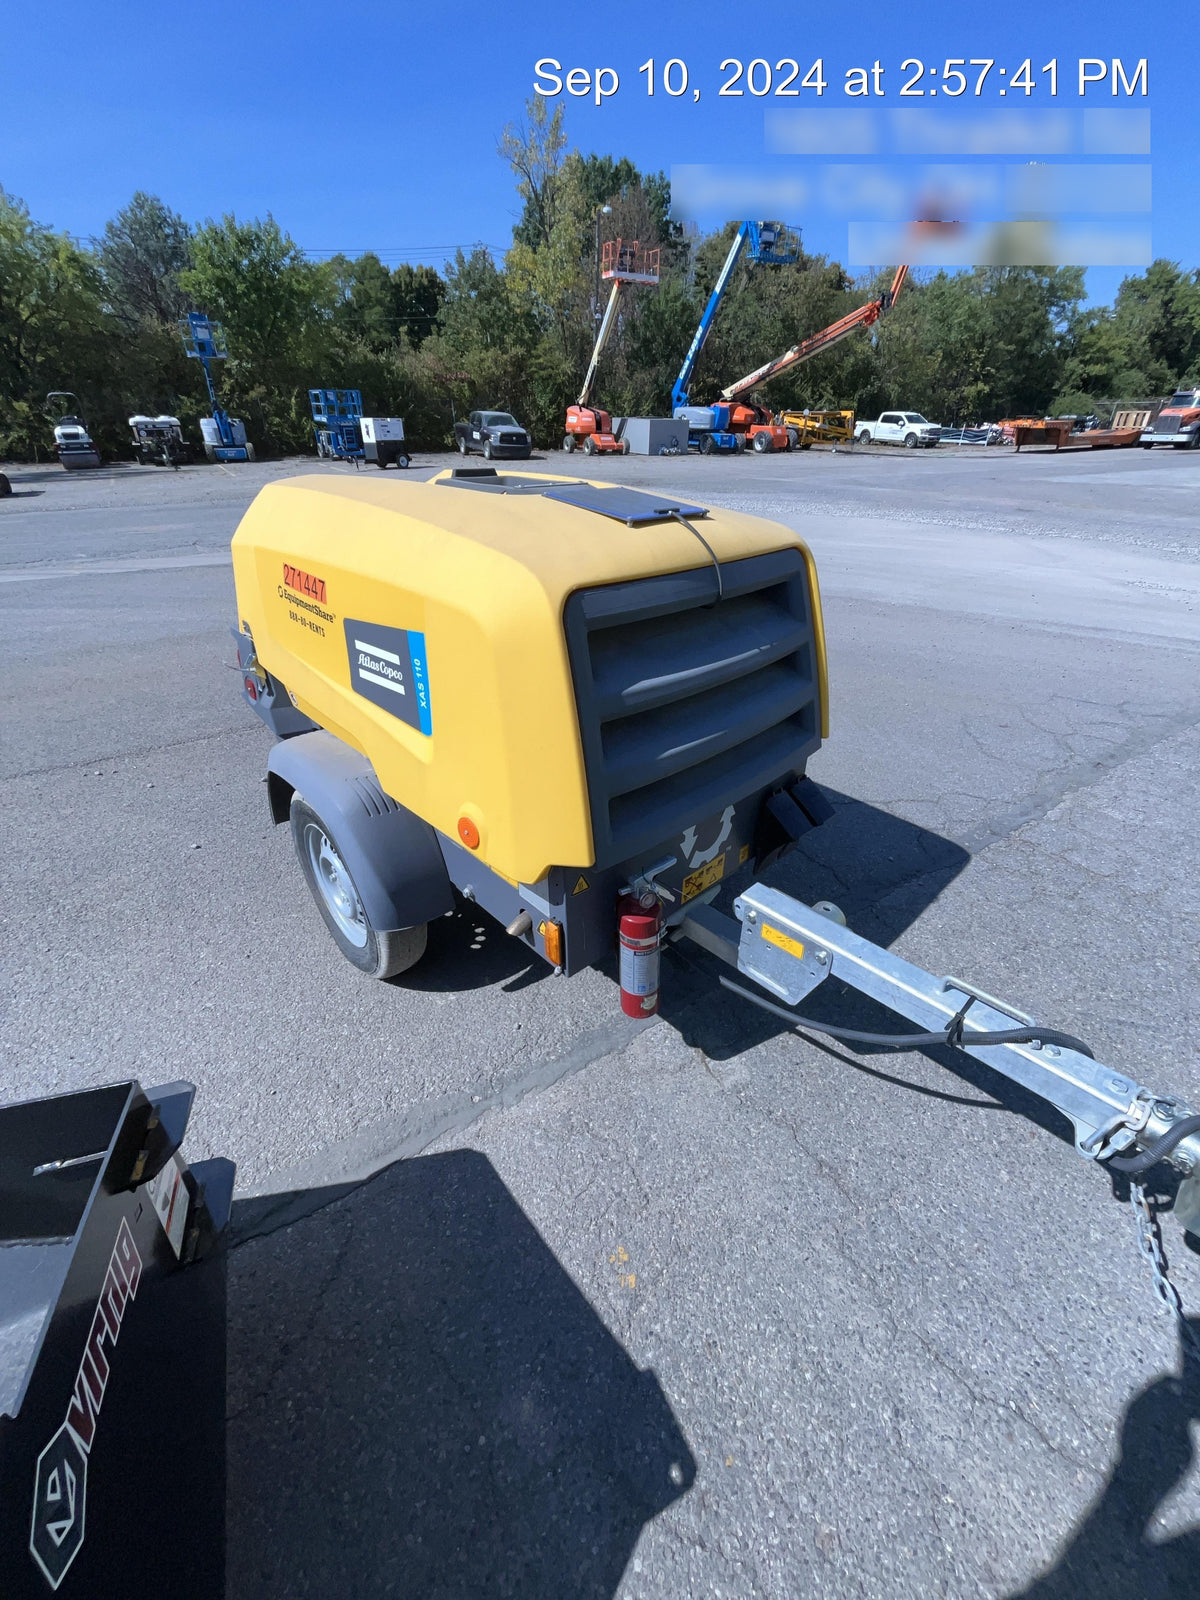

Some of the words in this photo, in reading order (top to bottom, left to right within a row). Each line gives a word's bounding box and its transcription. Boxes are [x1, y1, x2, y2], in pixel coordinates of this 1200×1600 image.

[283, 563, 326, 602] 271447
[283, 588, 334, 623] EquipmentShare
[358, 653, 380, 672] Atlas
[379, 660, 403, 681] Copco
[413, 658, 423, 678] 110
[417, 682, 427, 709] XAS
